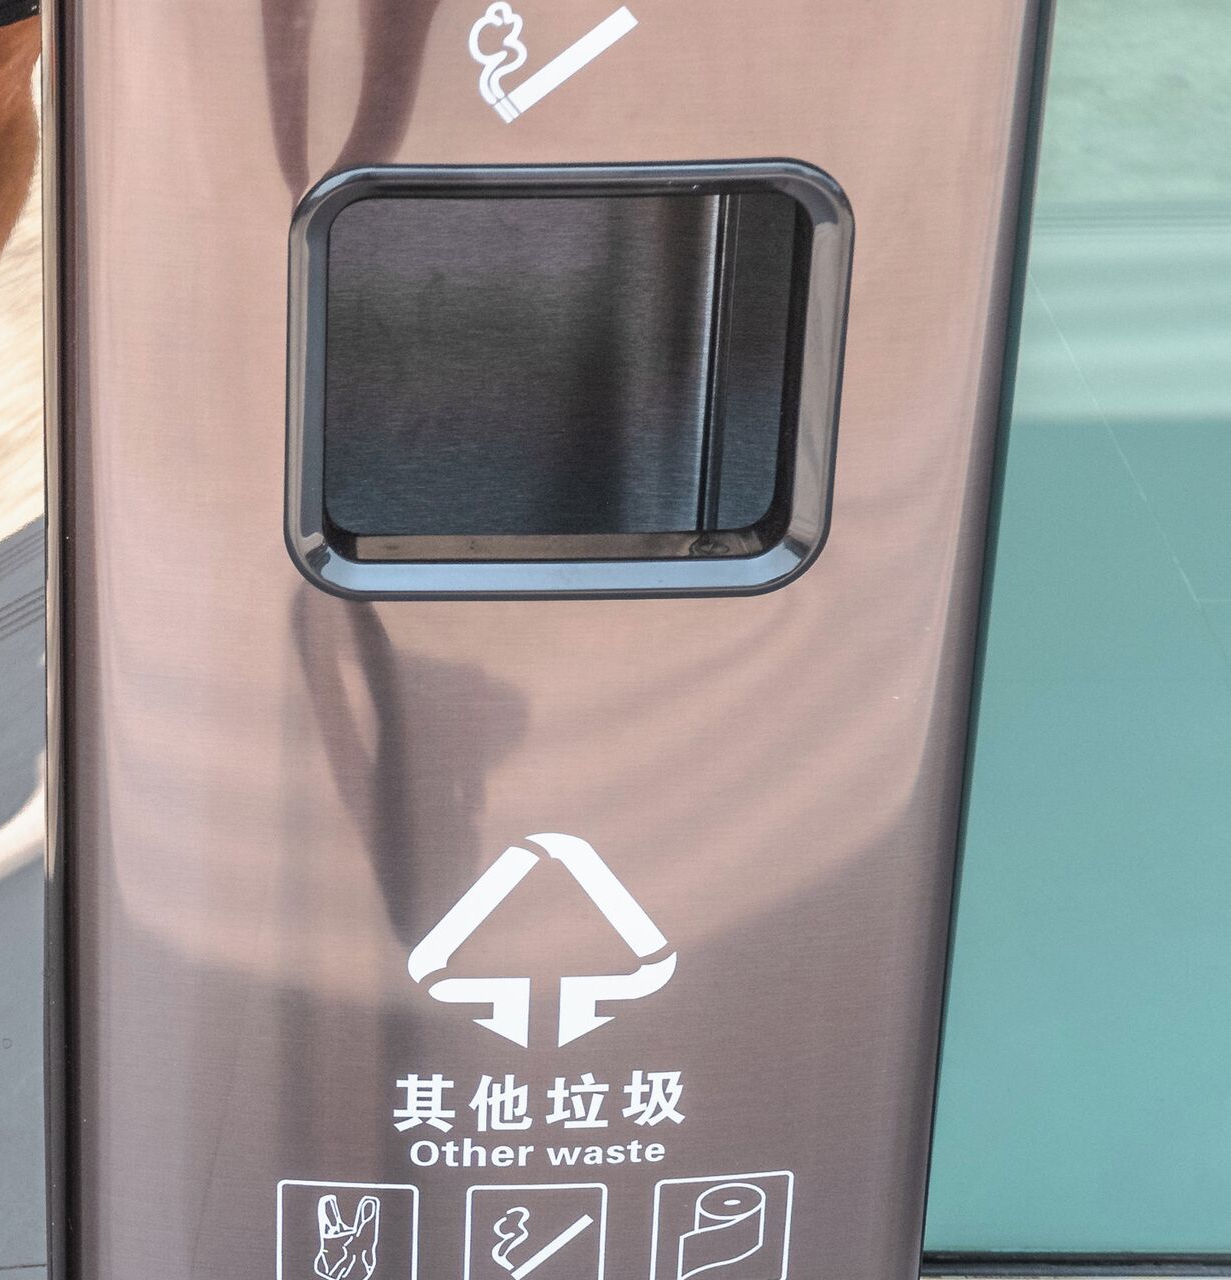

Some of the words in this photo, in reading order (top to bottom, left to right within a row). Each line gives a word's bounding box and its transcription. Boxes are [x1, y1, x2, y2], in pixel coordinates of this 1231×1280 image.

[393, 1070, 686, 1133] 其他垃圾
[409, 1137, 535, 1167] Other
[546, 1139, 666, 1166] waste
